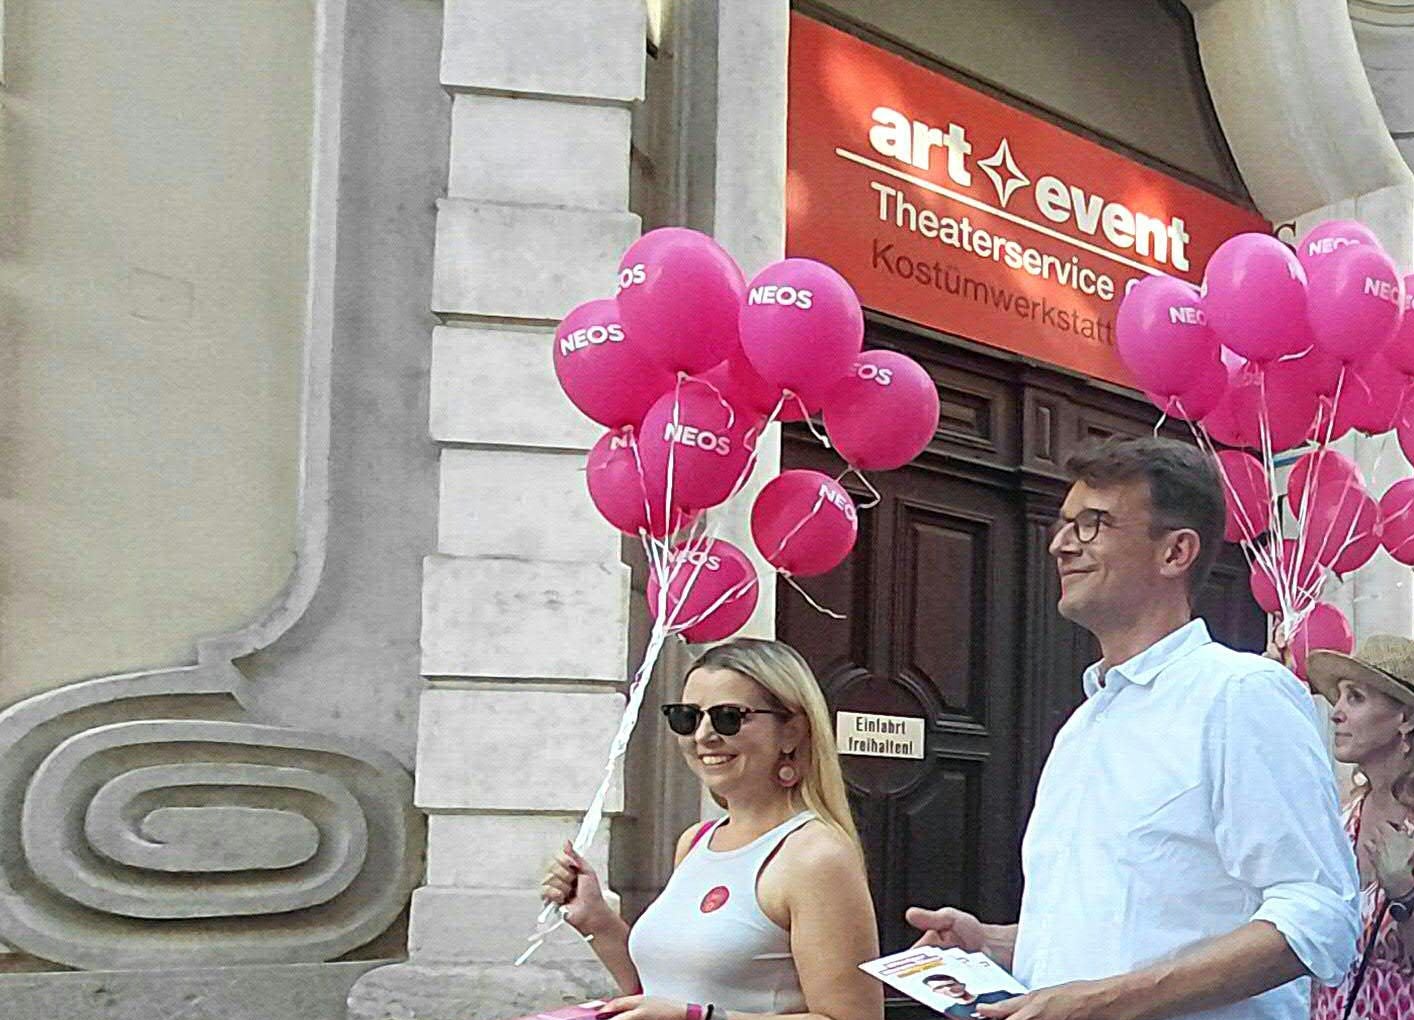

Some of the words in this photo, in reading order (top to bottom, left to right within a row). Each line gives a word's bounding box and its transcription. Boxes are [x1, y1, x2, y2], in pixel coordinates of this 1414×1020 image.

[868, 106, 972, 188] art
[1034, 175, 1190, 272] event
[870, 182, 1115, 301] Theaterservice
[616, 262, 646, 294] OS
[871, 238, 1114, 347] Kostümwerkstatt
[747, 286, 813, 310] NEOS
[559, 323, 625, 357] NEOS
[854, 363, 893, 386] OS
[663, 422, 731, 456] NEOS
[856, 716, 906, 735] Einfahrt
